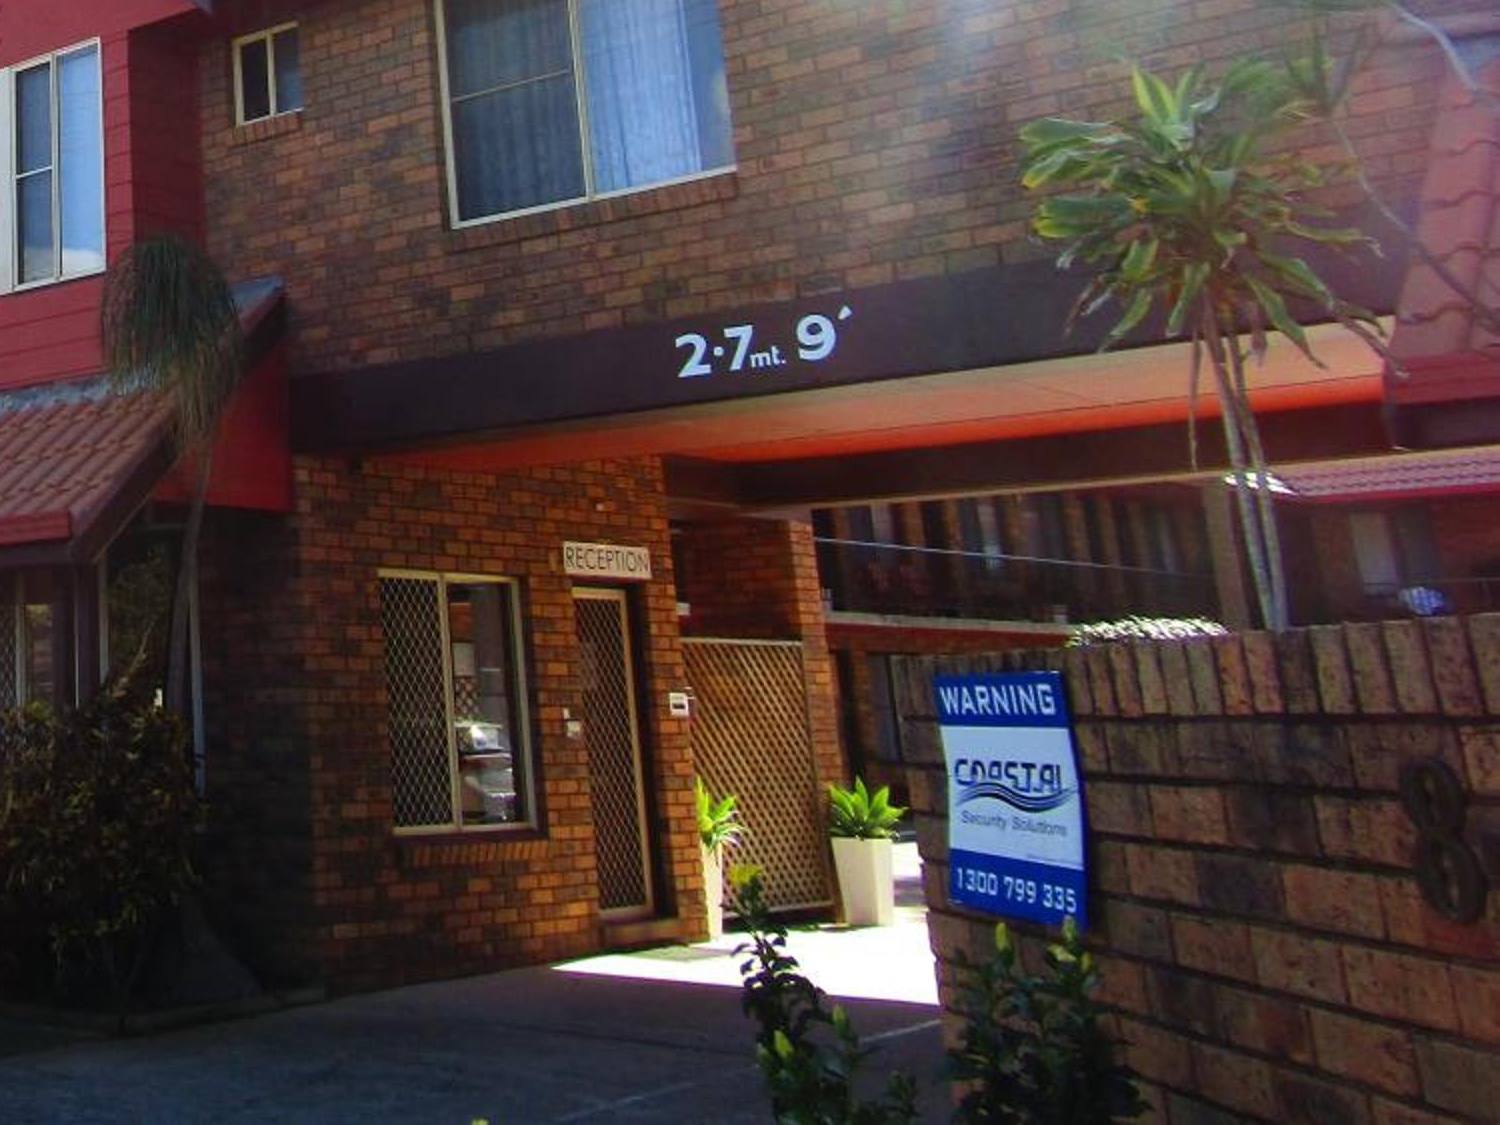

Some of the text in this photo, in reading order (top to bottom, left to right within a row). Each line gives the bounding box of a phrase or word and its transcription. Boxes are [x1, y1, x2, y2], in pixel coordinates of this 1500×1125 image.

[565, 546, 648, 572] RECEPTION
[939, 684, 1057, 716] WARNING
[961, 810, 1068, 837] Security Solutions
[957, 867, 1077, 914] 1300 799 335
